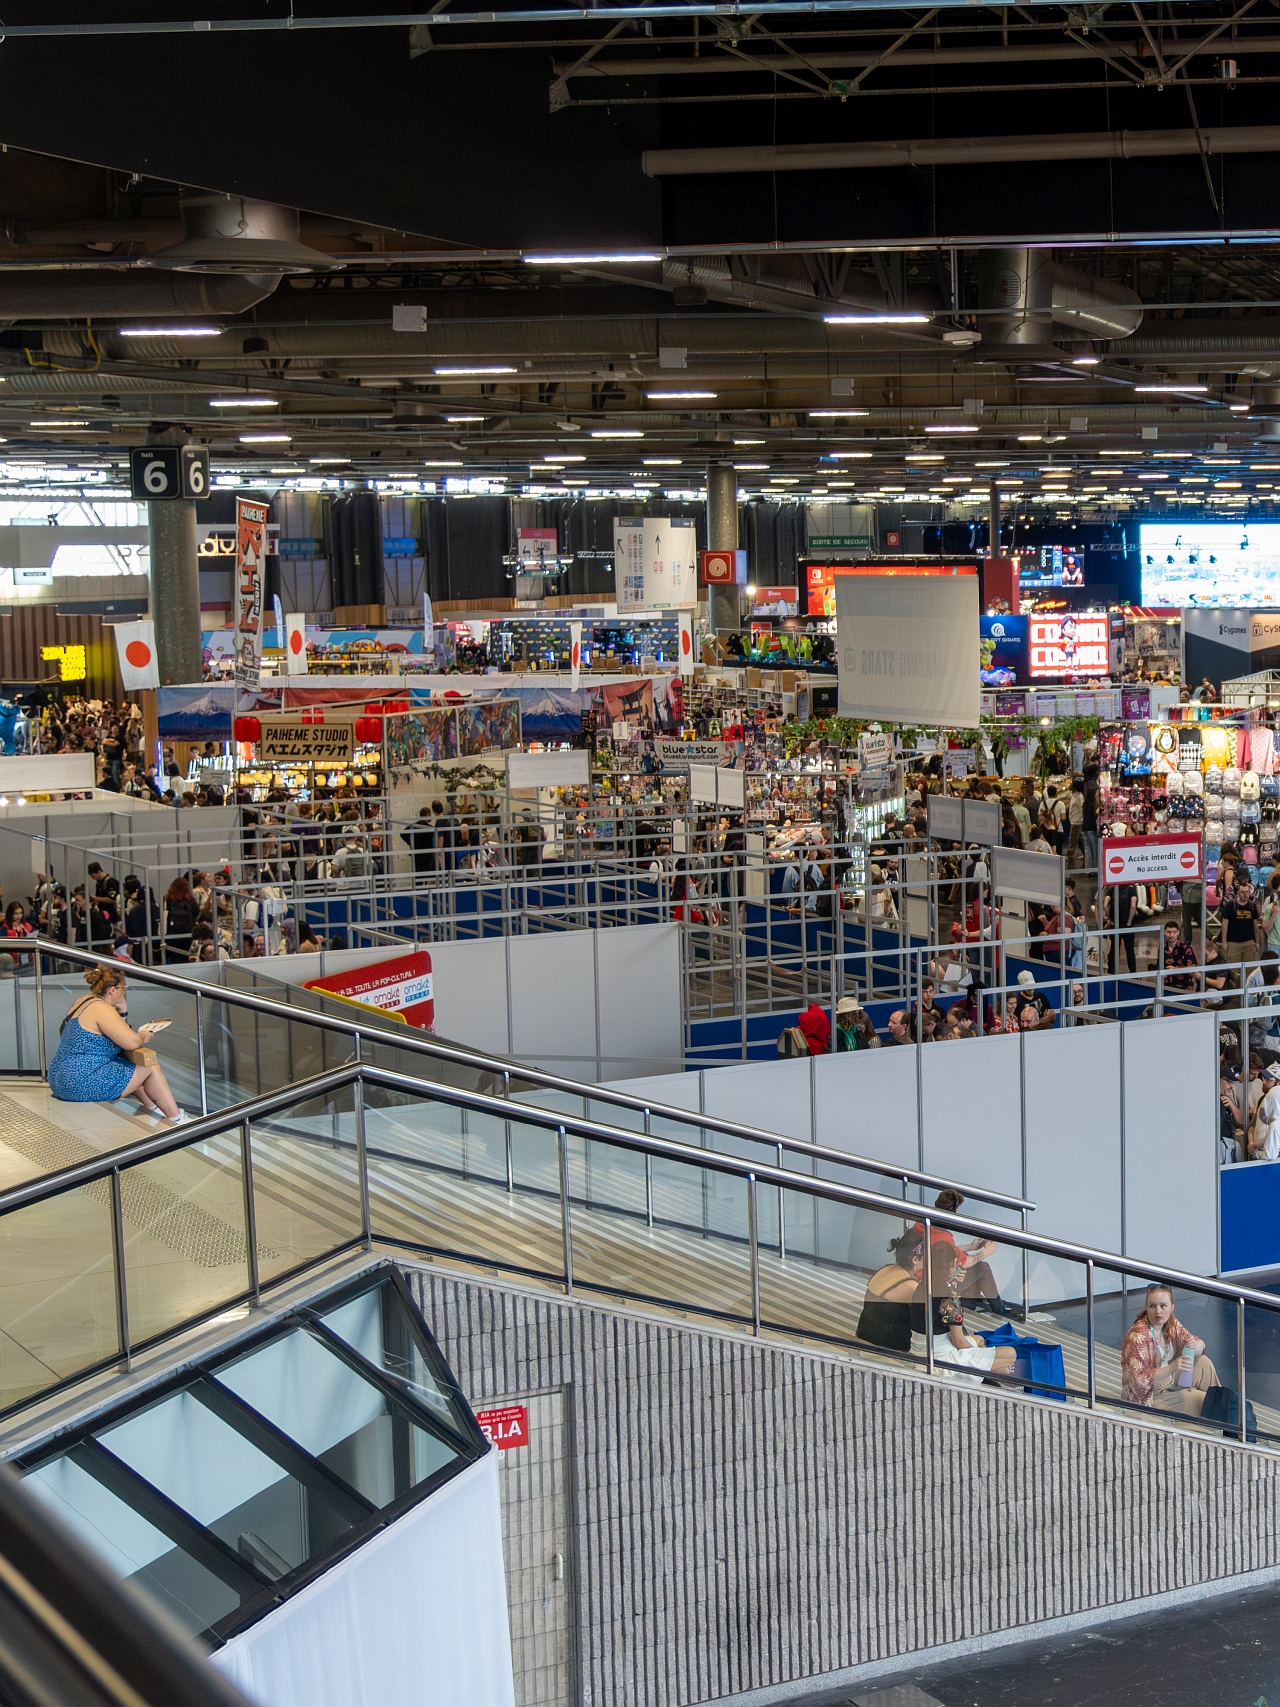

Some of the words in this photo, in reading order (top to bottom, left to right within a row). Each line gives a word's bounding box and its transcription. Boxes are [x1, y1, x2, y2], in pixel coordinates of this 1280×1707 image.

[144, 461, 168, 493] 6
[189, 461, 204, 493] 6
[1224, 624, 1246, 635] Cygames
[266, 728, 310, 741] PAIHEME
[312, 728, 349, 741] STUDIO
[662, 745, 685, 753] blue
[695, 745, 718, 753] star
[1128, 854, 1149, 863] Accès
[1151, 852, 1177, 861] interdit
[346, 987, 354, 995] DE
[354, 983, 372, 993] TOUTE
[372, 979, 380, 987] LA
[380, 972, 412, 986] POP-CULTURE
